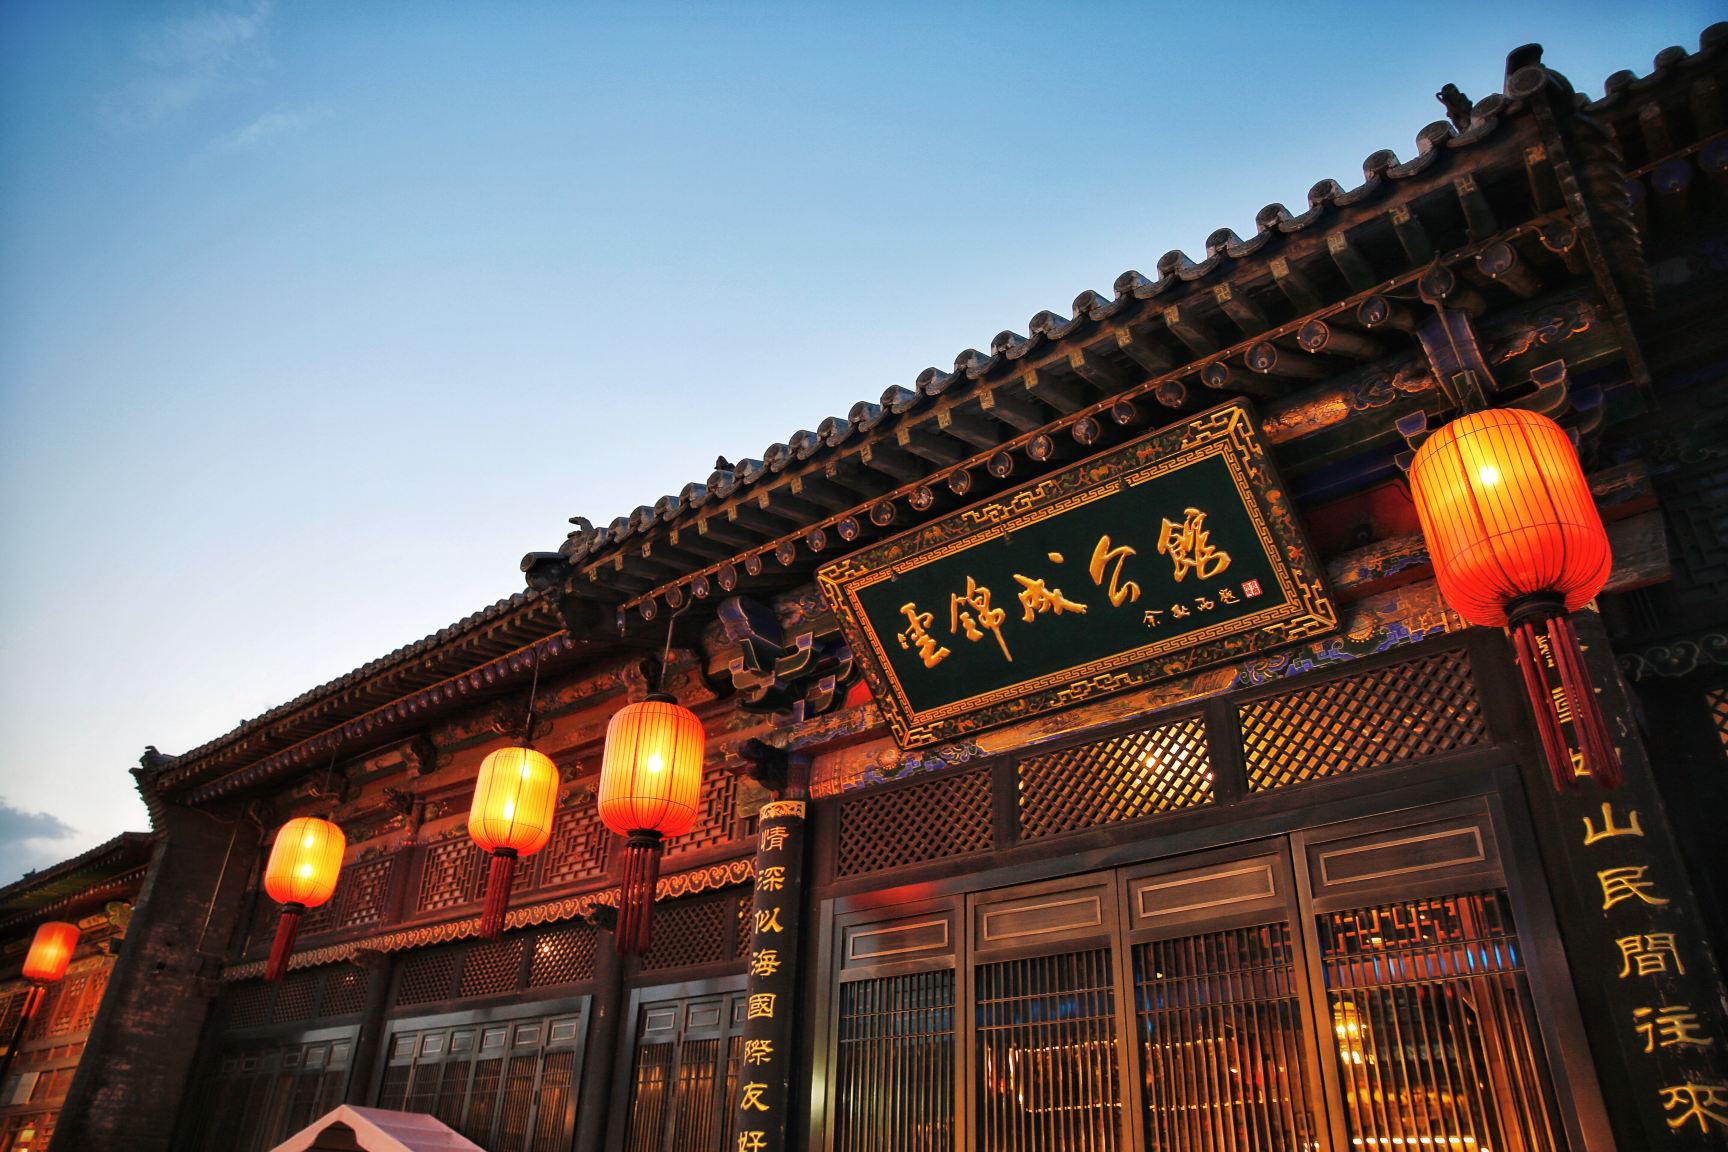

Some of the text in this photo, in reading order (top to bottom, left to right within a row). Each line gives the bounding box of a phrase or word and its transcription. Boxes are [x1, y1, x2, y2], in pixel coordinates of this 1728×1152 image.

[737, 825, 790, 1152] 情深似海國際友好
[1518, 632, 1728, 1134] 山民間往來
